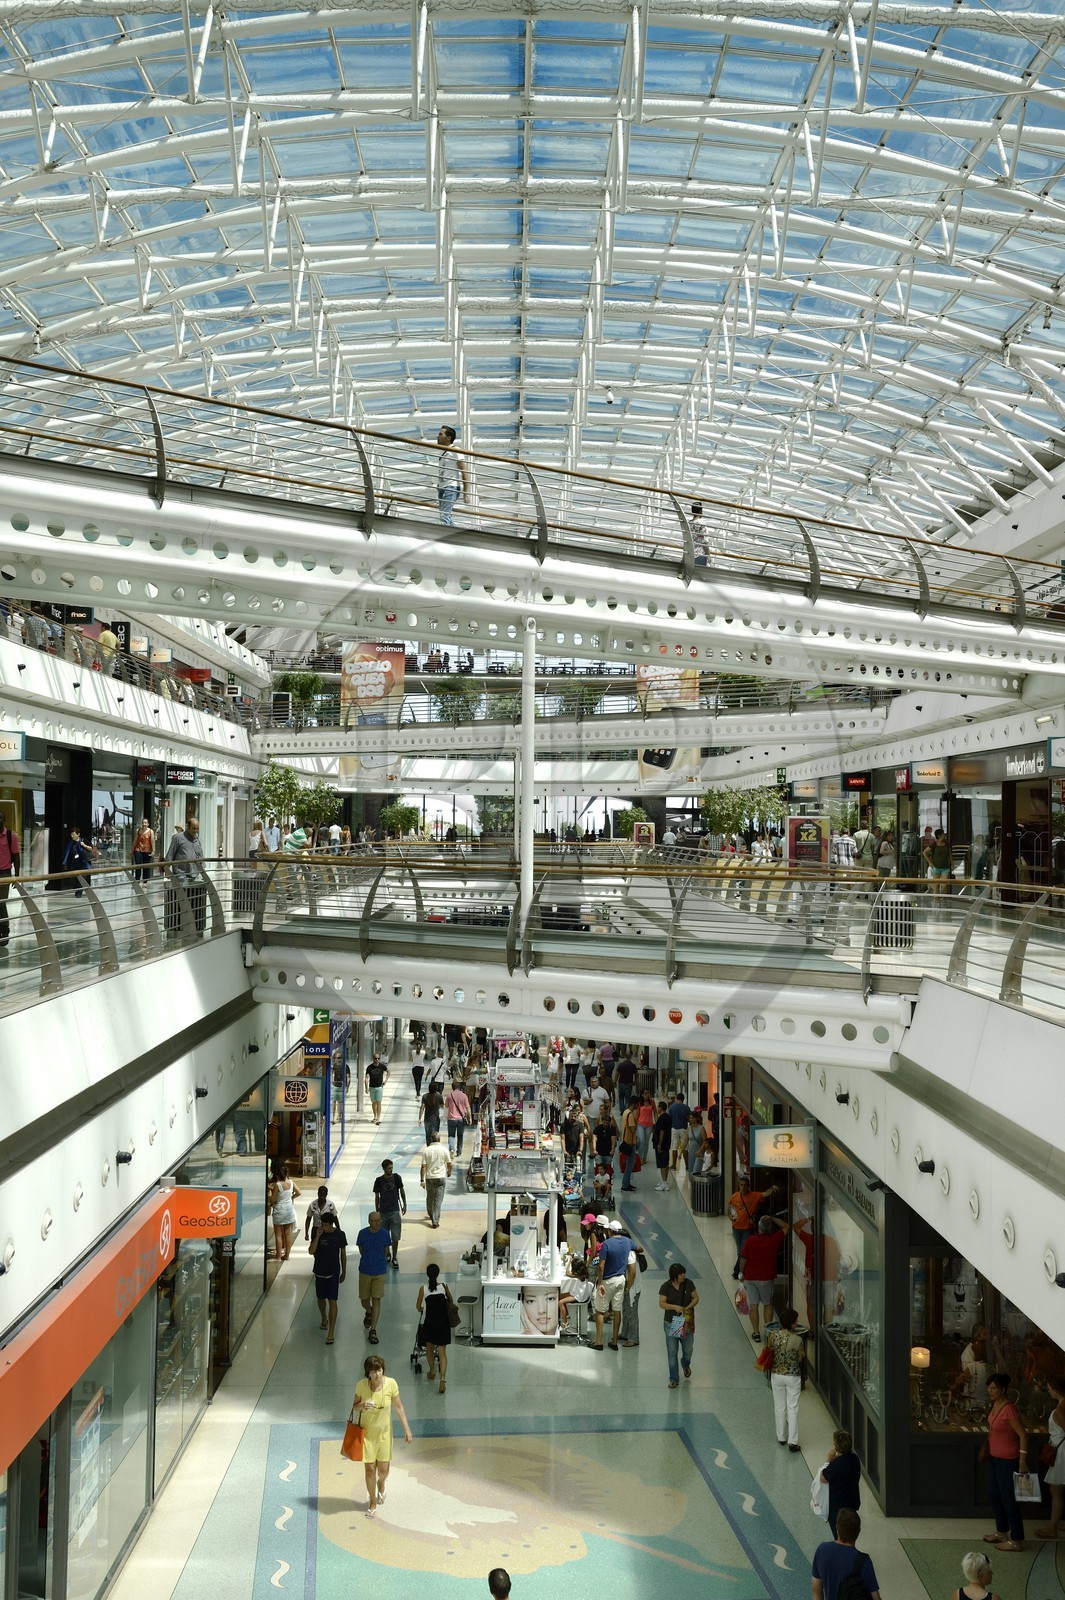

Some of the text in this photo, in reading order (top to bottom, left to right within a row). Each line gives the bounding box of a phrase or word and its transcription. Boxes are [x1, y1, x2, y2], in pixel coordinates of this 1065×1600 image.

[117, 624, 126, 650] nac
[375, 645, 404, 653] optimus
[357, 684, 385, 698] DOS
[1006, 752, 1036, 777] Timberland
[179, 1215, 235, 1227] GeoStar
